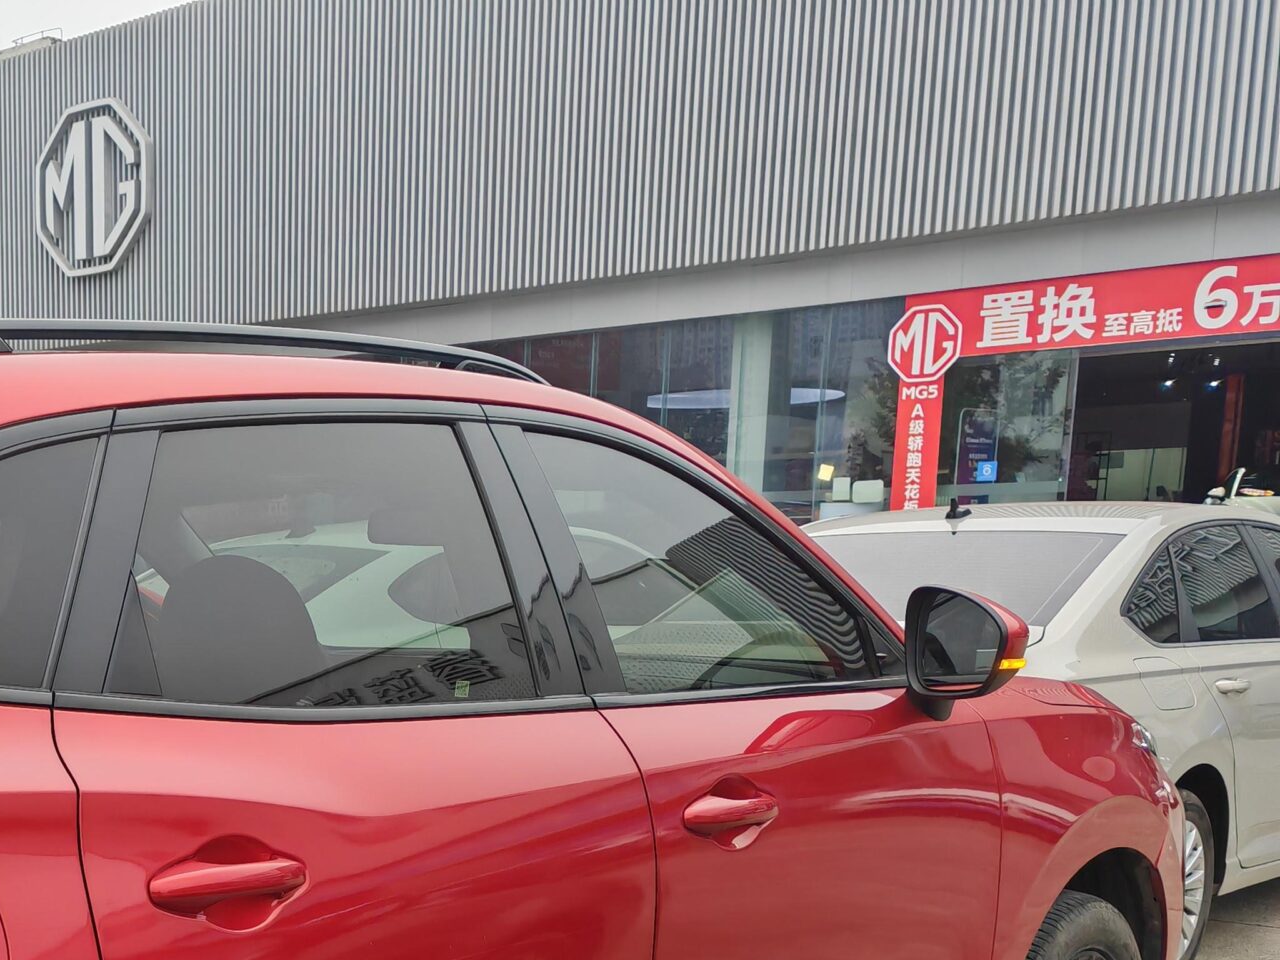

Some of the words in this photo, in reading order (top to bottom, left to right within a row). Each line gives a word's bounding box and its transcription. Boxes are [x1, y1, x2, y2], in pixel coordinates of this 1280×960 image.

[45, 114, 141, 262] MG
[892, 312, 956, 376] MG
[976, 283, 1096, 348] 置换
[1102, 308, 1183, 337] 至高抵
[902, 385, 938, 400] MG5
